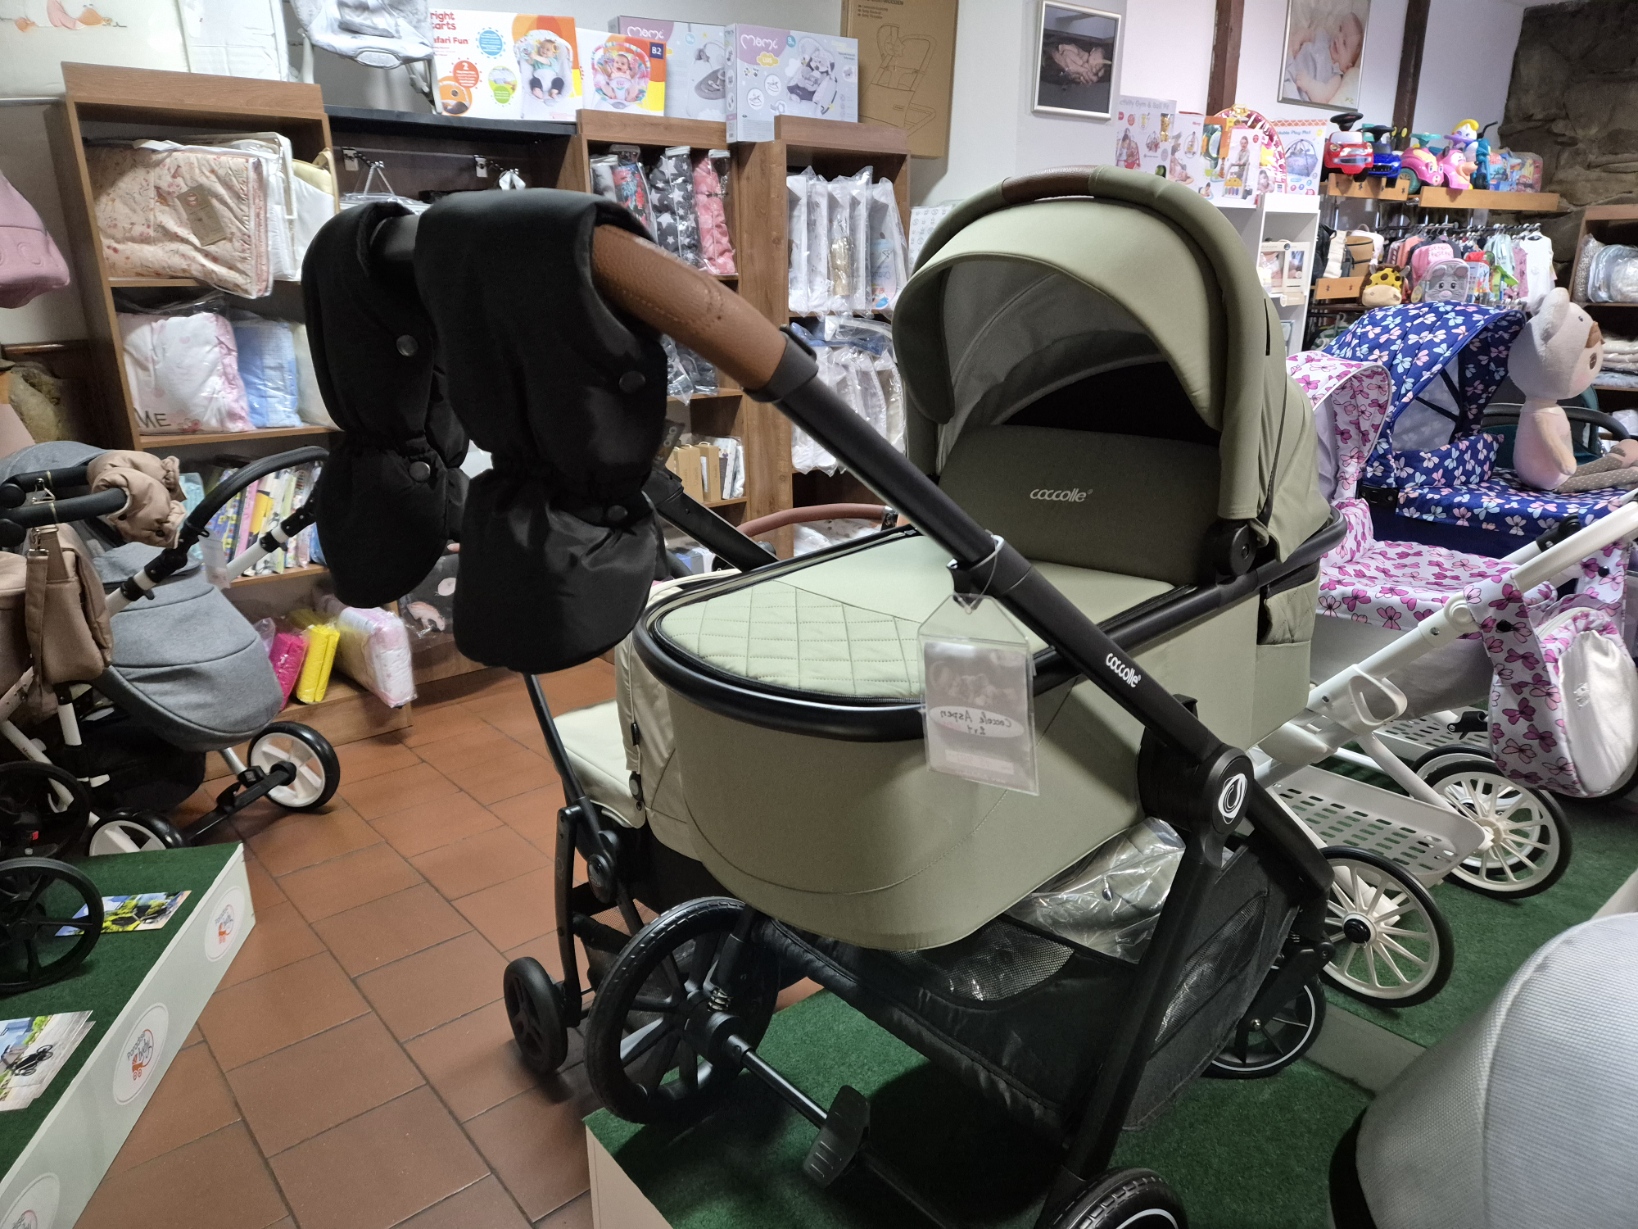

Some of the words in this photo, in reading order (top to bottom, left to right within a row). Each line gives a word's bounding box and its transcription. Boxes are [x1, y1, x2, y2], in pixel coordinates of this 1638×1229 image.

[430, 11, 454, 22] right
[432, 21, 456, 30] arts
[462, 62, 469, 70] 2
